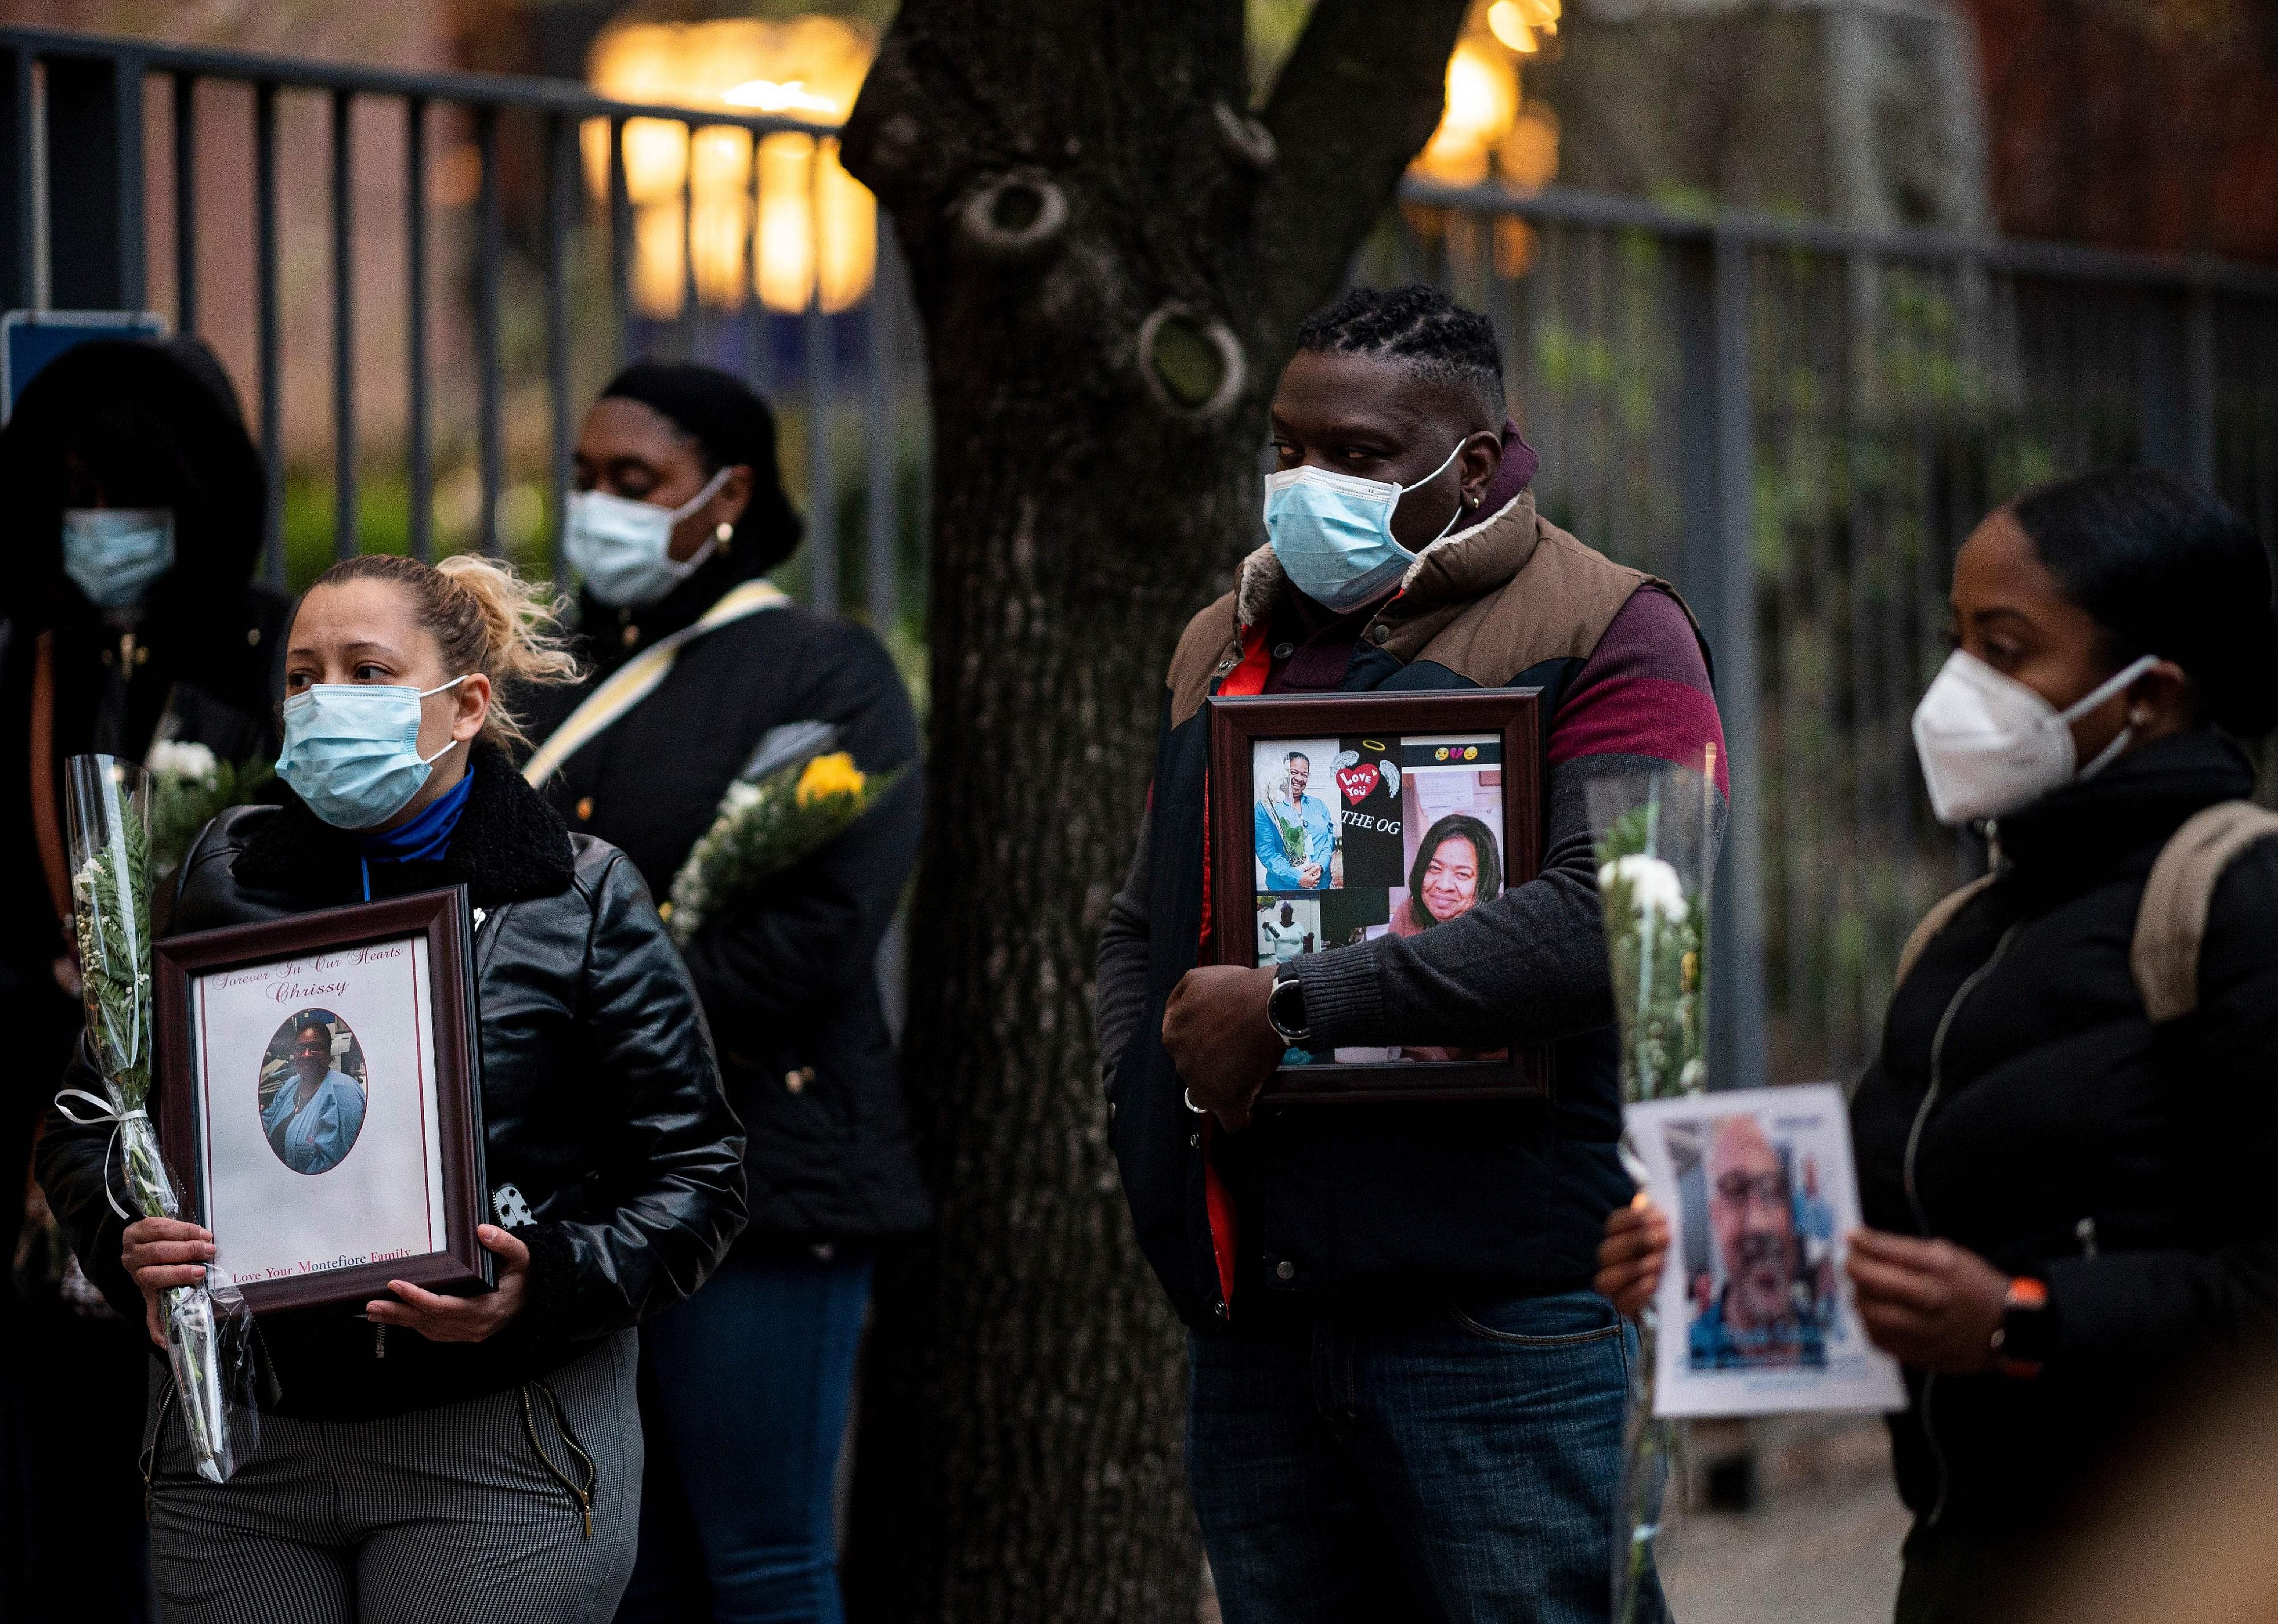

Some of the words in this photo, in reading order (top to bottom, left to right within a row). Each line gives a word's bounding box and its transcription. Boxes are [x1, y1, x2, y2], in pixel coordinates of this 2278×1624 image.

[1339, 772, 1371, 786] LOVE
[1341, 810, 1375, 829] THE
[1376, 818, 1401, 834] OG
[276, 960, 301, 978] In
[309, 954, 342, 973] Our
[347, 945, 404, 965] Hearts
[266, 981, 350, 1004] Chrissy
[233, 1272, 261, 1283] Love
[265, 1267, 293, 1279] Your
[298, 1254, 366, 1274] Montefiore
[370, 1248, 411, 1263] Family
